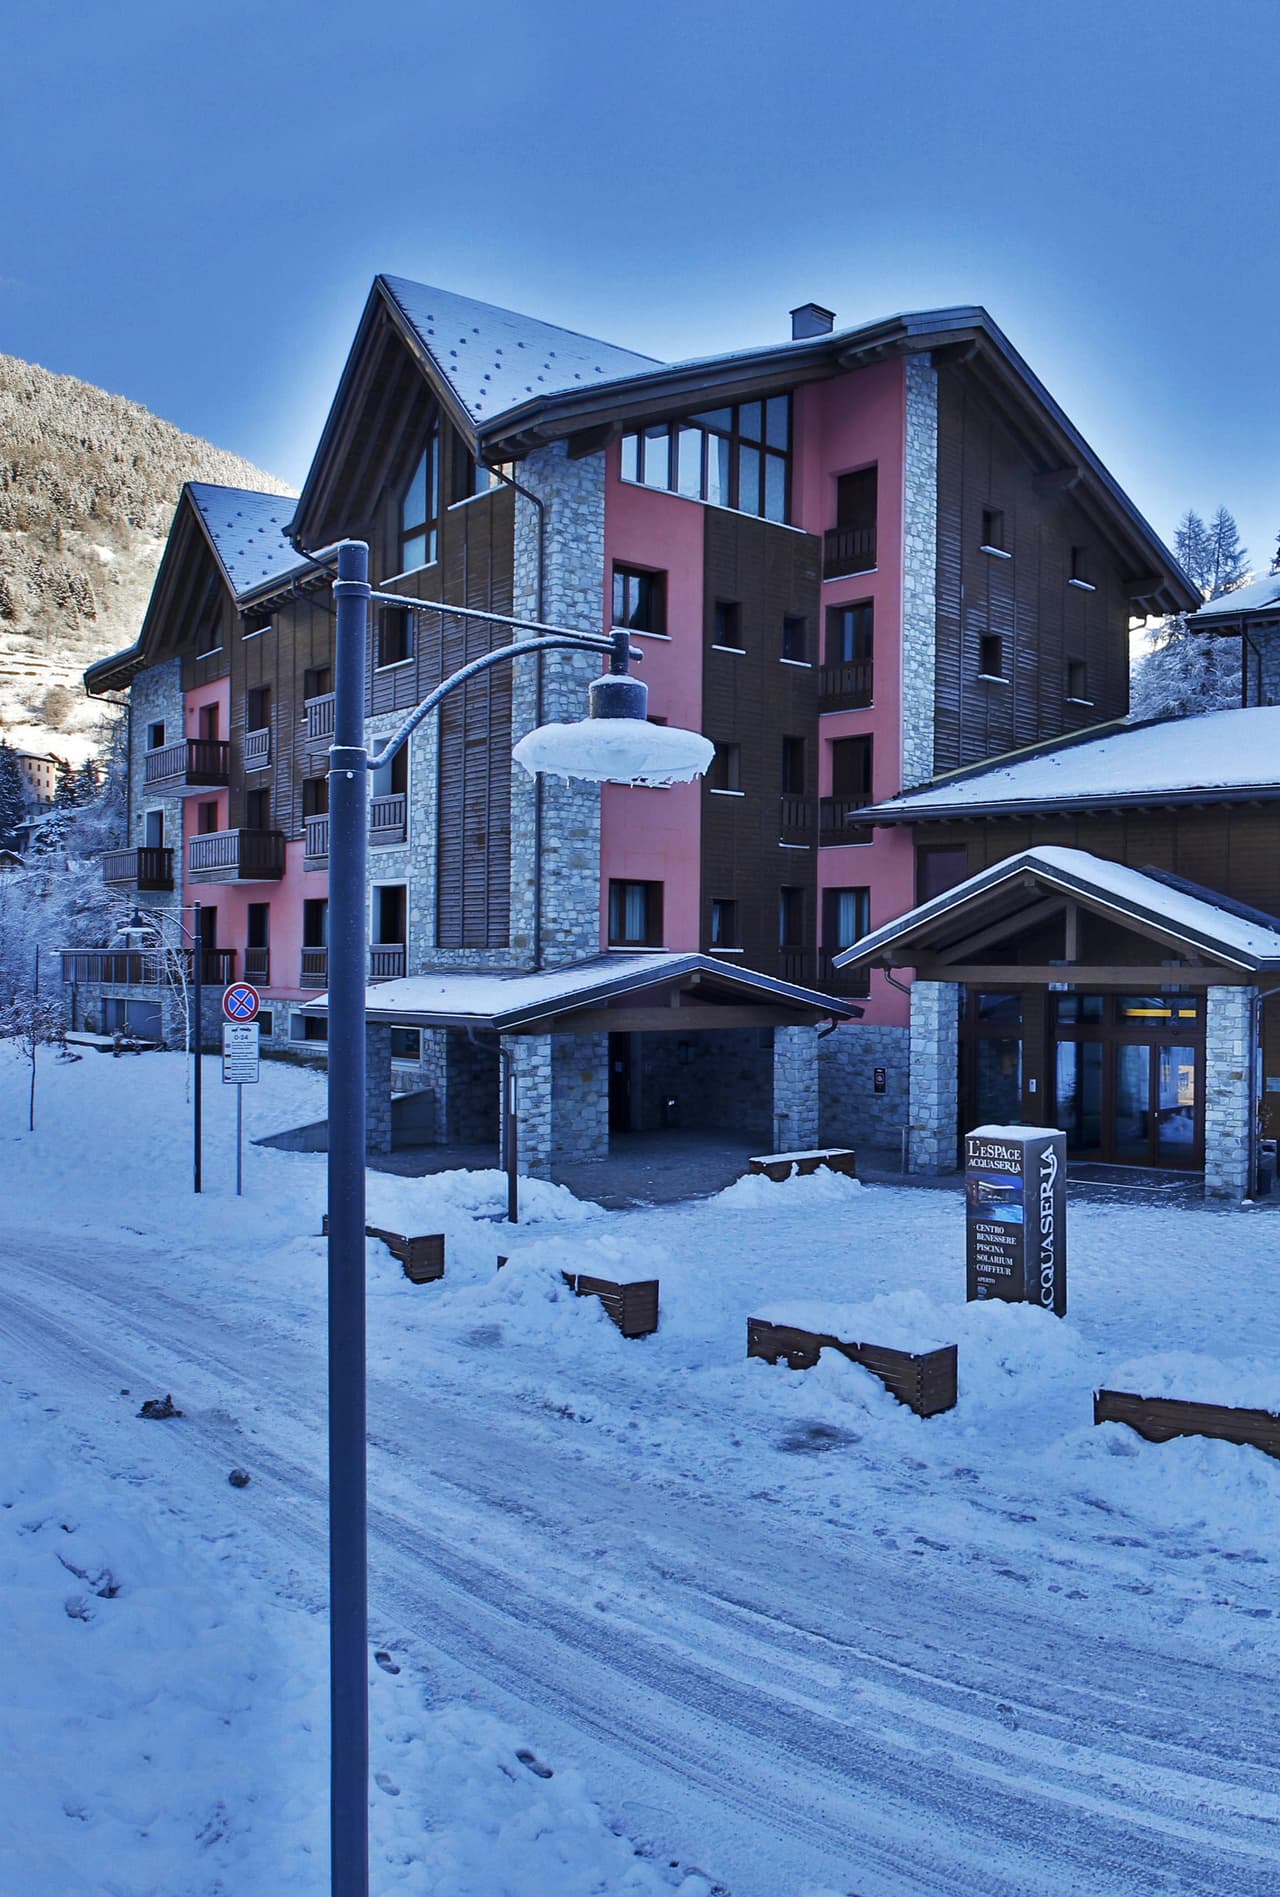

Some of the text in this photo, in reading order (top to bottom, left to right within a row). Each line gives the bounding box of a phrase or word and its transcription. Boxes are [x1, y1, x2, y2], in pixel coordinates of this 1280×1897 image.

[968, 1158, 1021, 1174] ACQUASERIA
[976, 1223, 1004, 1234] CENTRO
[976, 1232, 1016, 1245] BENESSERE
[976, 1243, 1004, 1254] PISCINA
[976, 1253, 1013, 1265] SOLARIUM
[976, 1263, 1011, 1276] COIFFEUR
